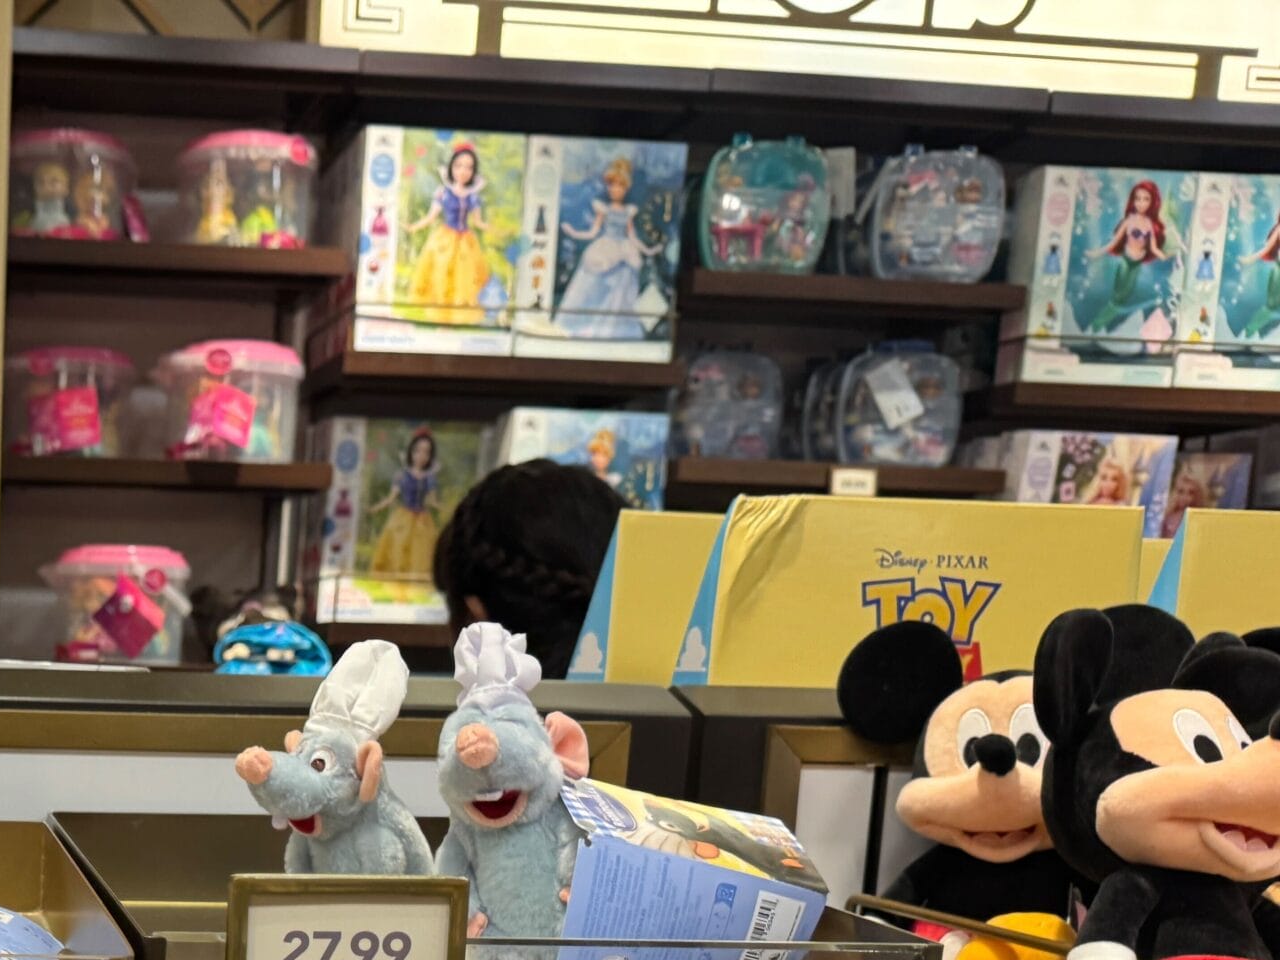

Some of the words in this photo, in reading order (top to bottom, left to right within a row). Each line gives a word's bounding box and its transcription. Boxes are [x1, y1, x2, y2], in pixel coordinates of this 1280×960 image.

[873, 548, 928, 574] Disney
[936, 554, 989, 569] PIXAR
[862, 577, 1001, 645] TOY
